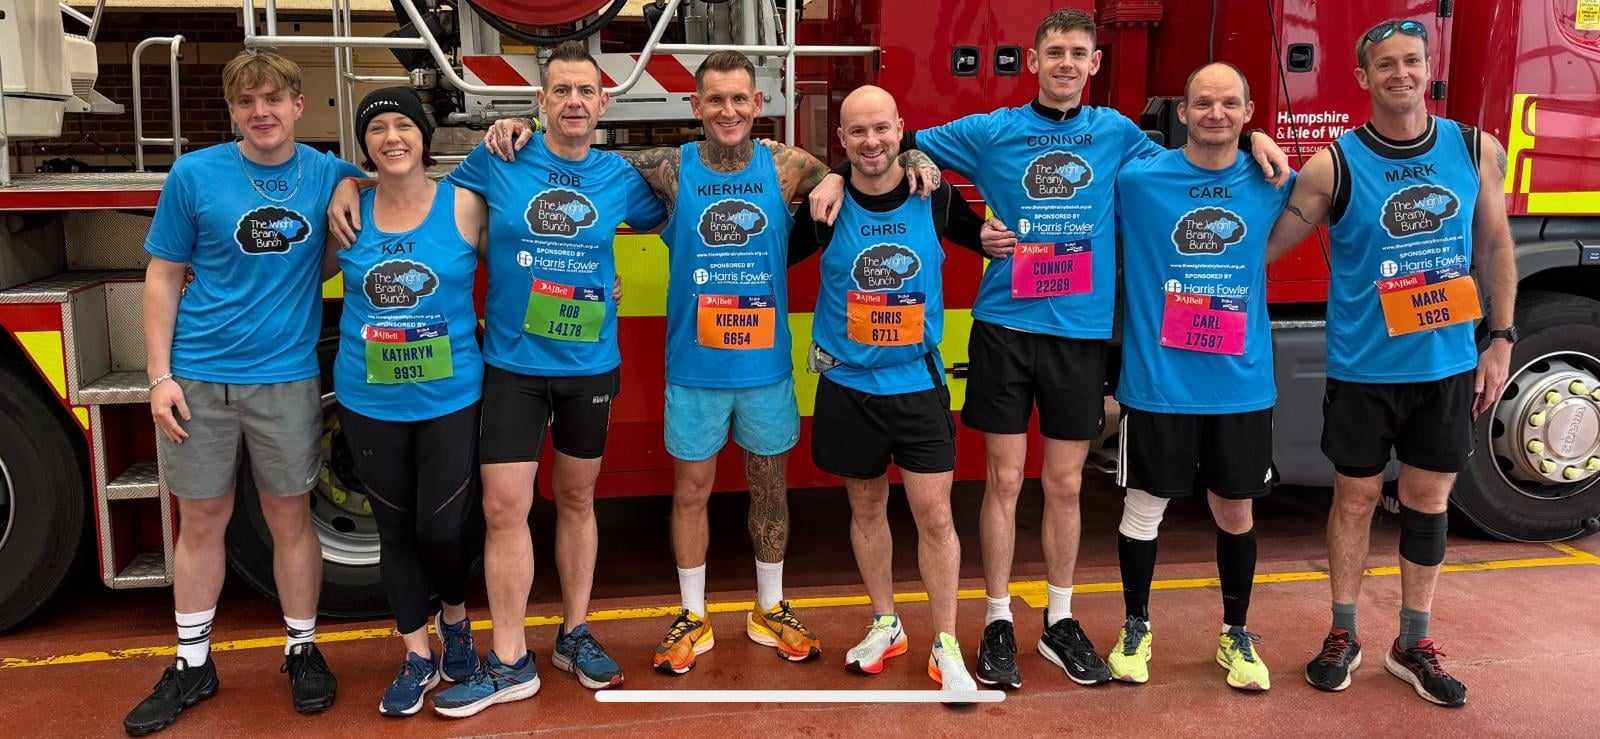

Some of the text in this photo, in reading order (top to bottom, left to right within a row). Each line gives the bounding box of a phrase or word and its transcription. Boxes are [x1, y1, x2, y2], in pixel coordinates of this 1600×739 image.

[1277, 111, 1349, 126] Hampshire
[1276, 127, 1285, 139] &
[1287, 126, 1310, 139] Isle
[1311, 126, 1326, 139] of
[1027, 134, 1093, 147] CONNOR
[1035, 165, 1052, 174] The
[1384, 164, 1438, 183] MARK
[253, 179, 289, 192] ROB
[548, 172, 581, 187] ROB
[697, 183, 764, 197] KIERHAN
[1039, 184, 1068, 194] Bunch
[1189, 186, 1232, 199] CARL
[538, 200, 556, 209] The
[1392, 201, 1412, 211] The
[709, 212, 726, 221] The
[249, 220, 267, 229] The
[542, 220, 570, 232] Bunch
[861, 223, 907, 237] CHRIS
[1032, 222, 1062, 232] Harris
[1063, 221, 1095, 232] Fowler
[1185, 220, 1203, 230] The
[1401, 219, 1433, 232] Bunch
[714, 232, 741, 241] Bunch
[256, 239, 282, 248] Bunch
[382, 242, 416, 255] KAT
[1189, 240, 1218, 250] Bunch
[536, 248, 576, 257] SPONSORED
[1400, 248, 1441, 258] SPONSORED
[534, 257, 566, 269] Harris
[567, 259, 600, 270] Fowler
[863, 257, 880, 266] The
[1033, 260, 1073, 276] CONNOR
[1400, 258, 1433, 271] Harris
[372, 273, 391, 283] The
[709, 271, 738, 281] Harris
[740, 271, 772, 281] Fowler
[868, 276, 895, 286] Bunch
[1184, 284, 1215, 294] Harris
[1217, 284, 1249, 294] Fowler
[380, 294, 410, 304] Bunch
[1411, 288, 1448, 308] MARK
[559, 304, 580, 319] ROB
[871, 311, 902, 324] CHRIS
[1417, 307, 1450, 326] 1626
[716, 313, 759, 327] KIERHAN
[1193, 314, 1222, 329] CARL
[547, 320, 583, 337] 14178
[723, 332, 751, 345] 6654
[1185, 332, 1224, 349] 17587
[382, 345, 433, 361] KATHRYN
